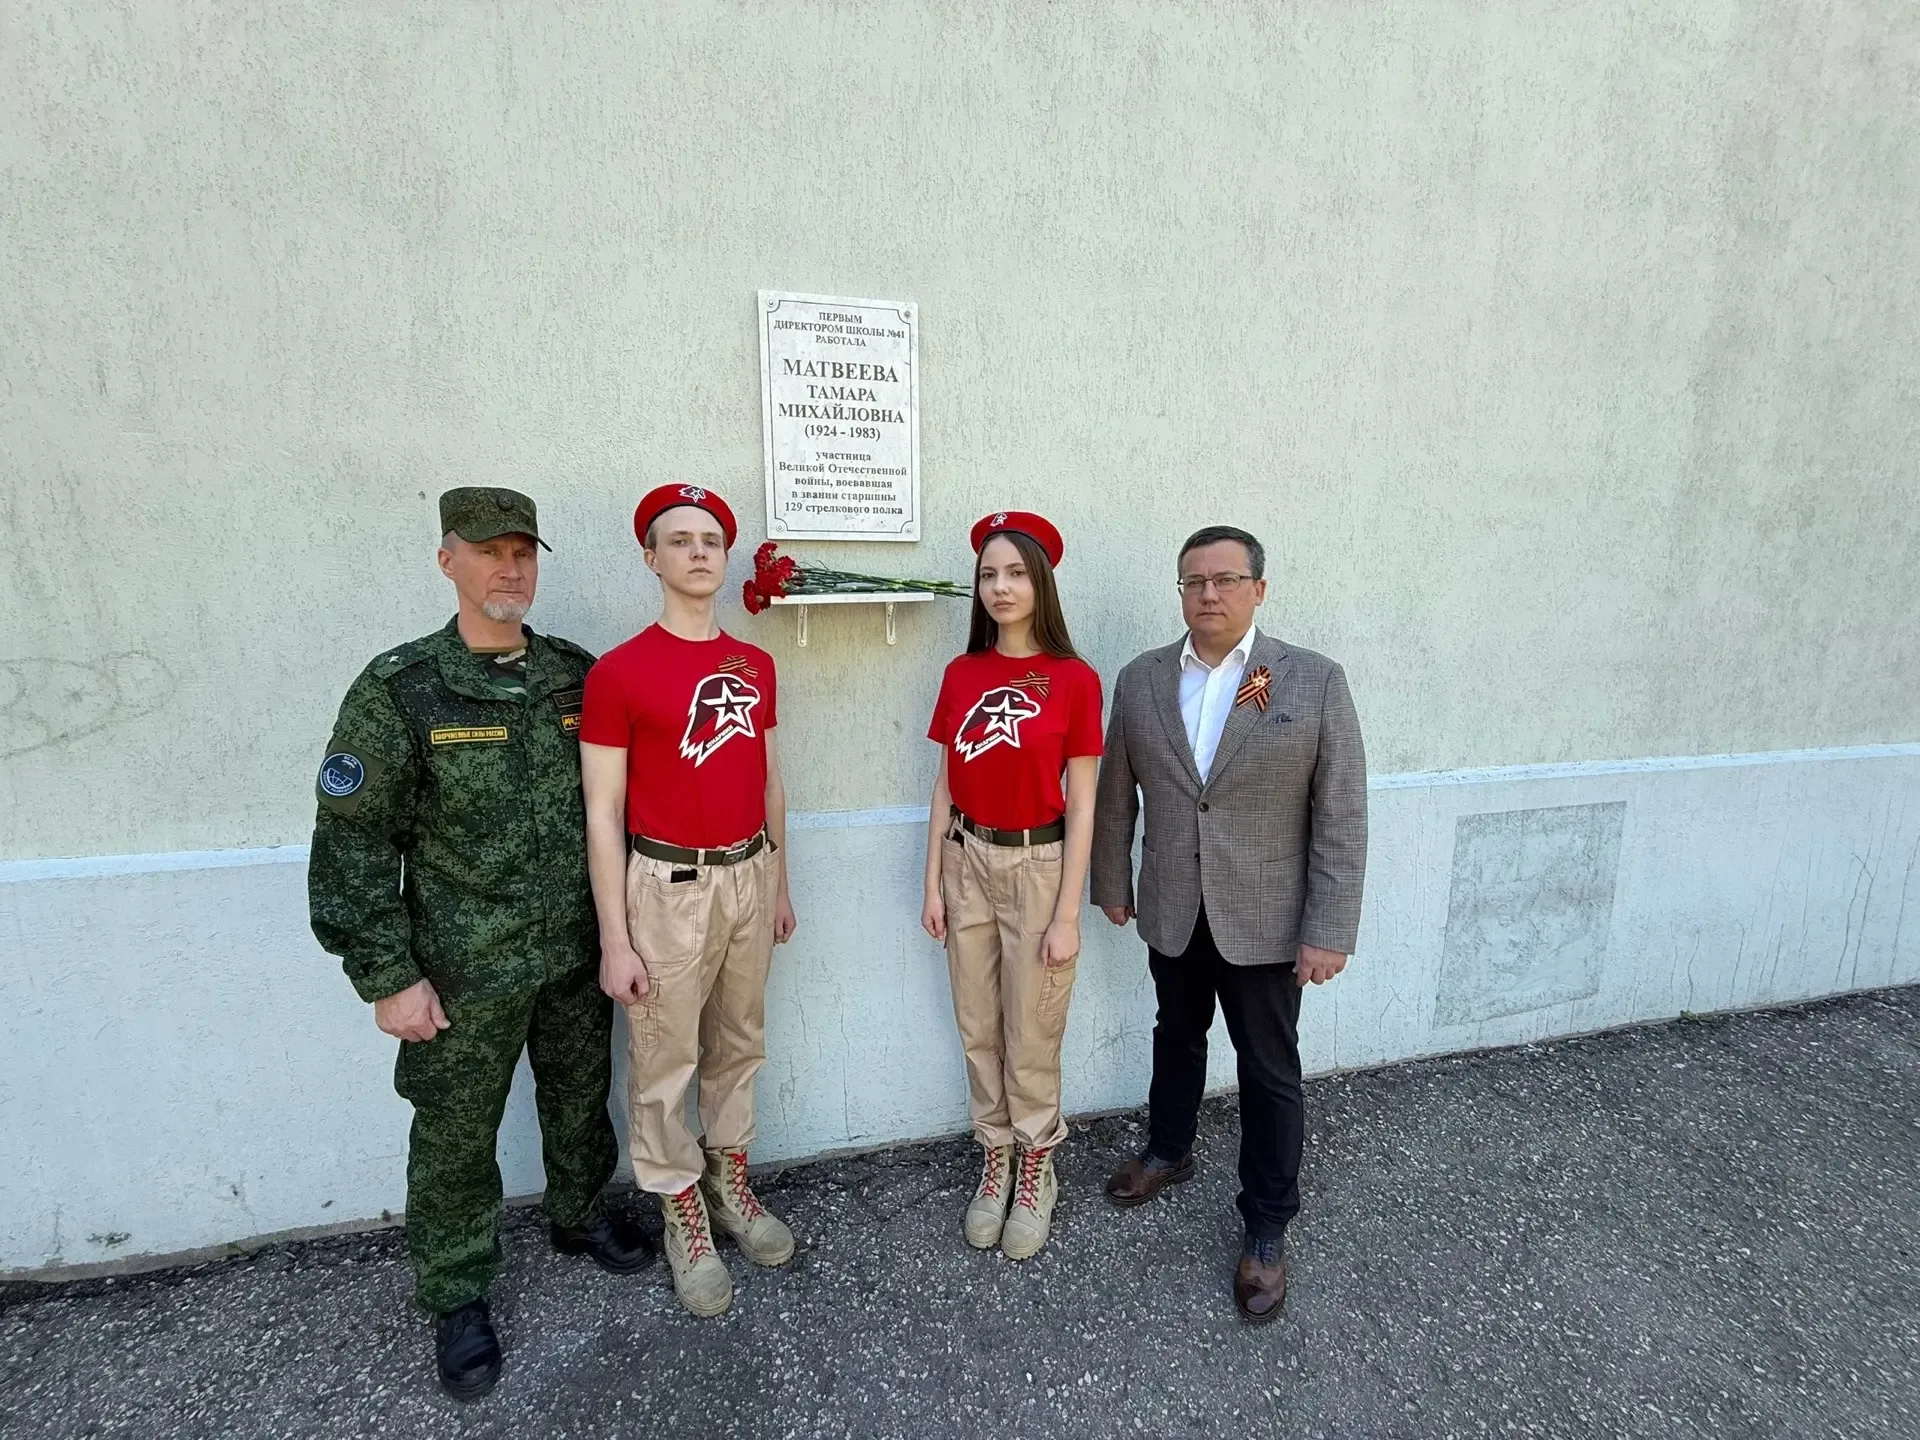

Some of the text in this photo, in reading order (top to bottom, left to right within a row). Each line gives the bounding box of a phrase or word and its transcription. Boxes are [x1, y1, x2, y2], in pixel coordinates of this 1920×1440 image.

[819, 312, 862, 324] ПЕРВЫМ
[773, 320, 905, 339] ДИРЕКТОРОМ ШКОЛЫ №41
[815, 334, 867, 347] РАБОТАЛА
[782, 358, 899, 383] МАТВЕЕВА
[806, 384, 877, 402] ТАМАРА
[778, 403, 905, 424] МИХАЙЛОВНА
[804, 424, 838, 439] (1924
[849, 427, 881, 442] 1983)
[815, 451, 872, 462] участница
[779, 461, 907, 476] Великой Отечественной
[794, 476, 893, 488] войны, воевавшая
[800, 492, 838, 500] звании
[841, 492, 896, 502] старшины
[785, 502, 803, 512] 129
[805, 504, 870, 515] стрелкового
